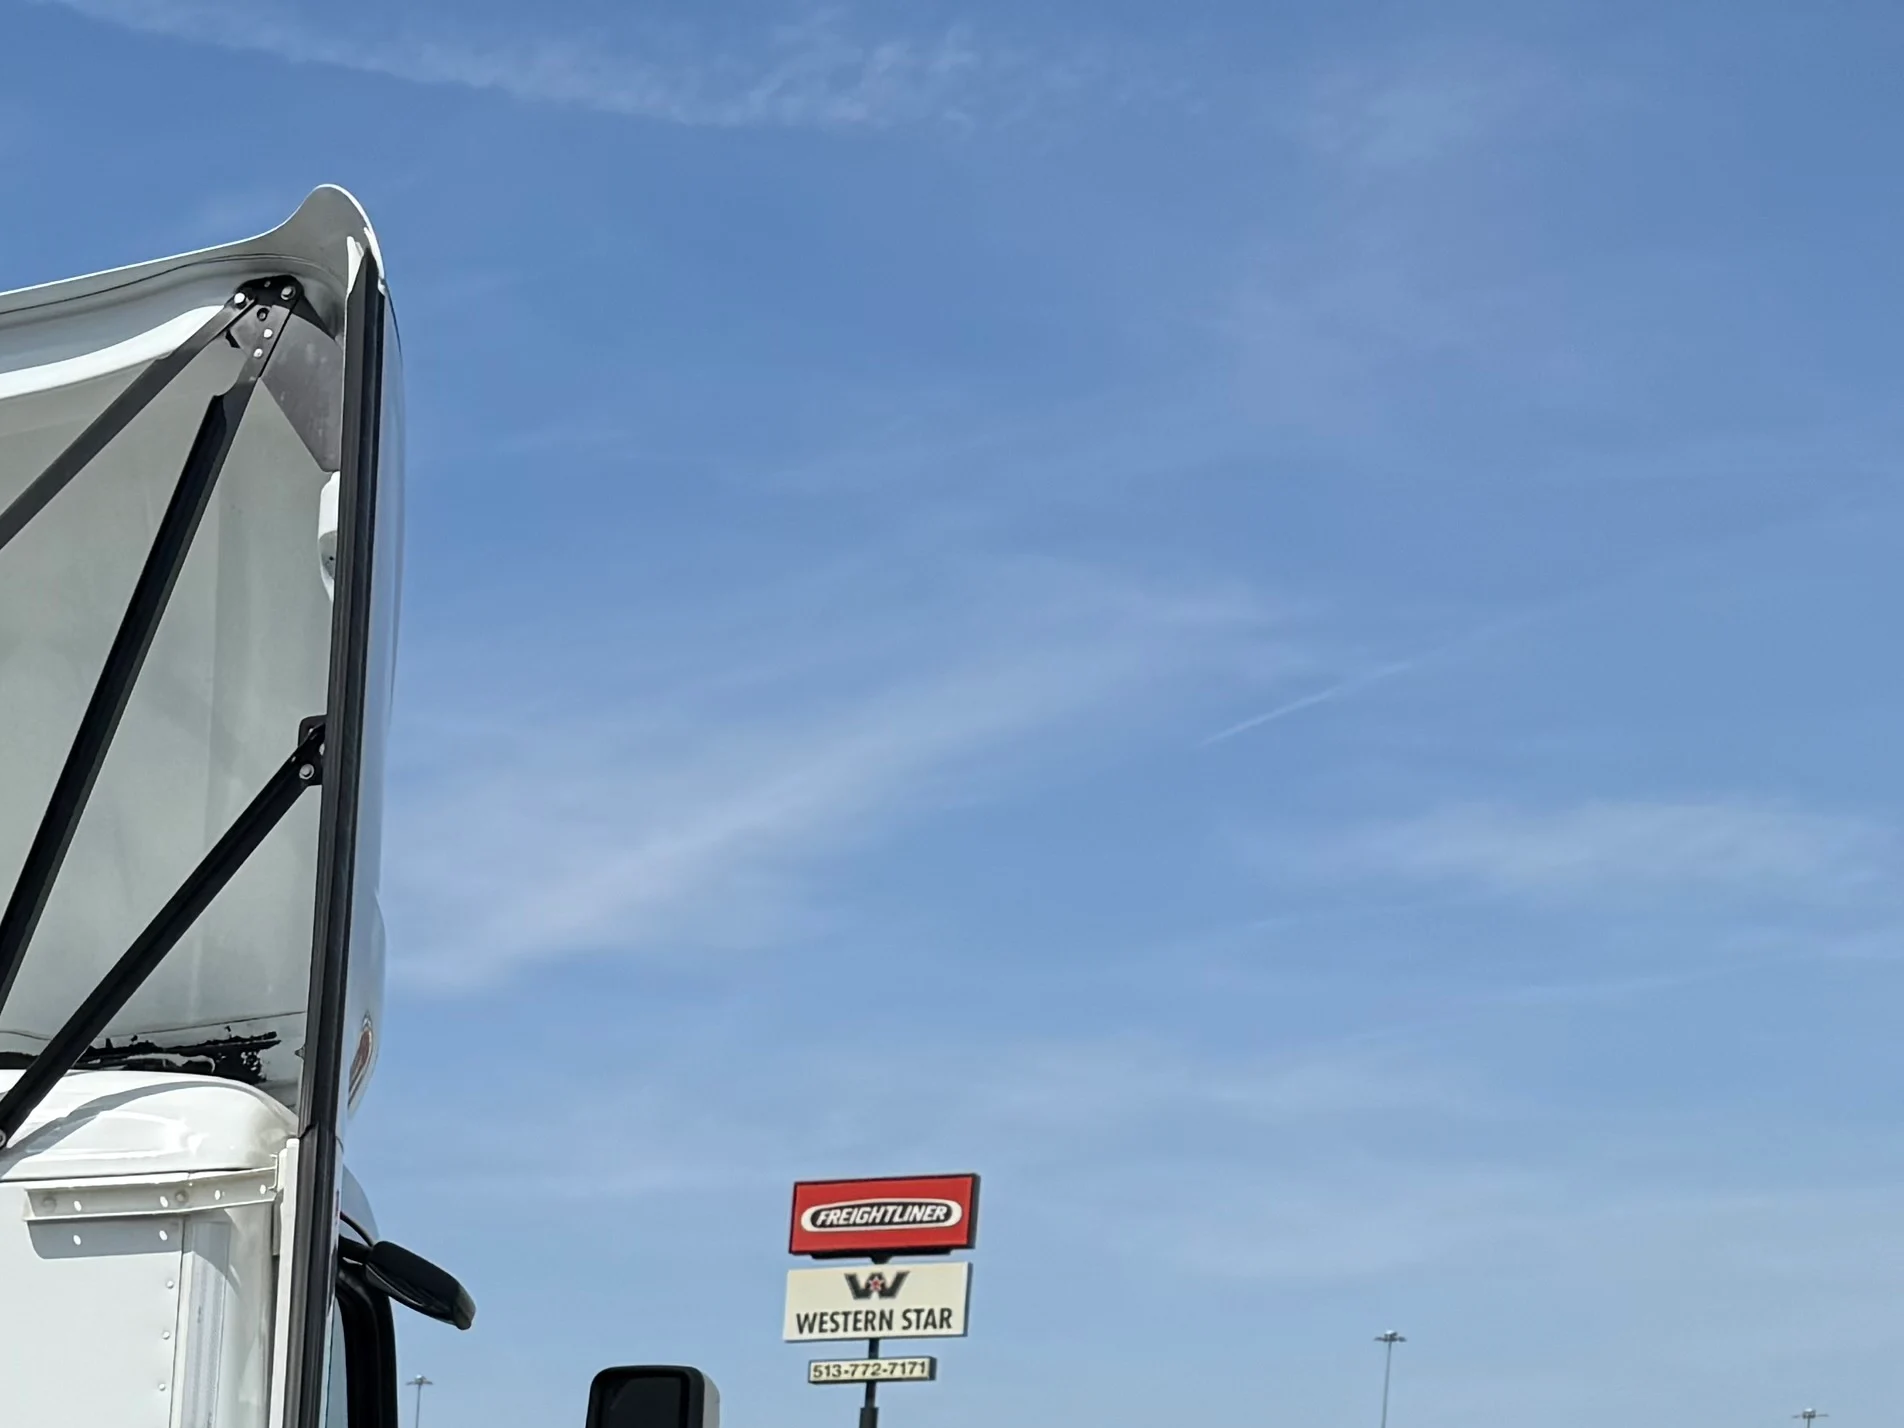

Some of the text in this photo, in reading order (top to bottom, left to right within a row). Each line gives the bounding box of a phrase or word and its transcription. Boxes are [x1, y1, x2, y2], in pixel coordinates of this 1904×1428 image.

[816, 1204, 948, 1227] FREIGHTLINER
[796, 1307, 953, 1335] WESTERN STAR
[812, 1360, 926, 1379] 513-772-7171
